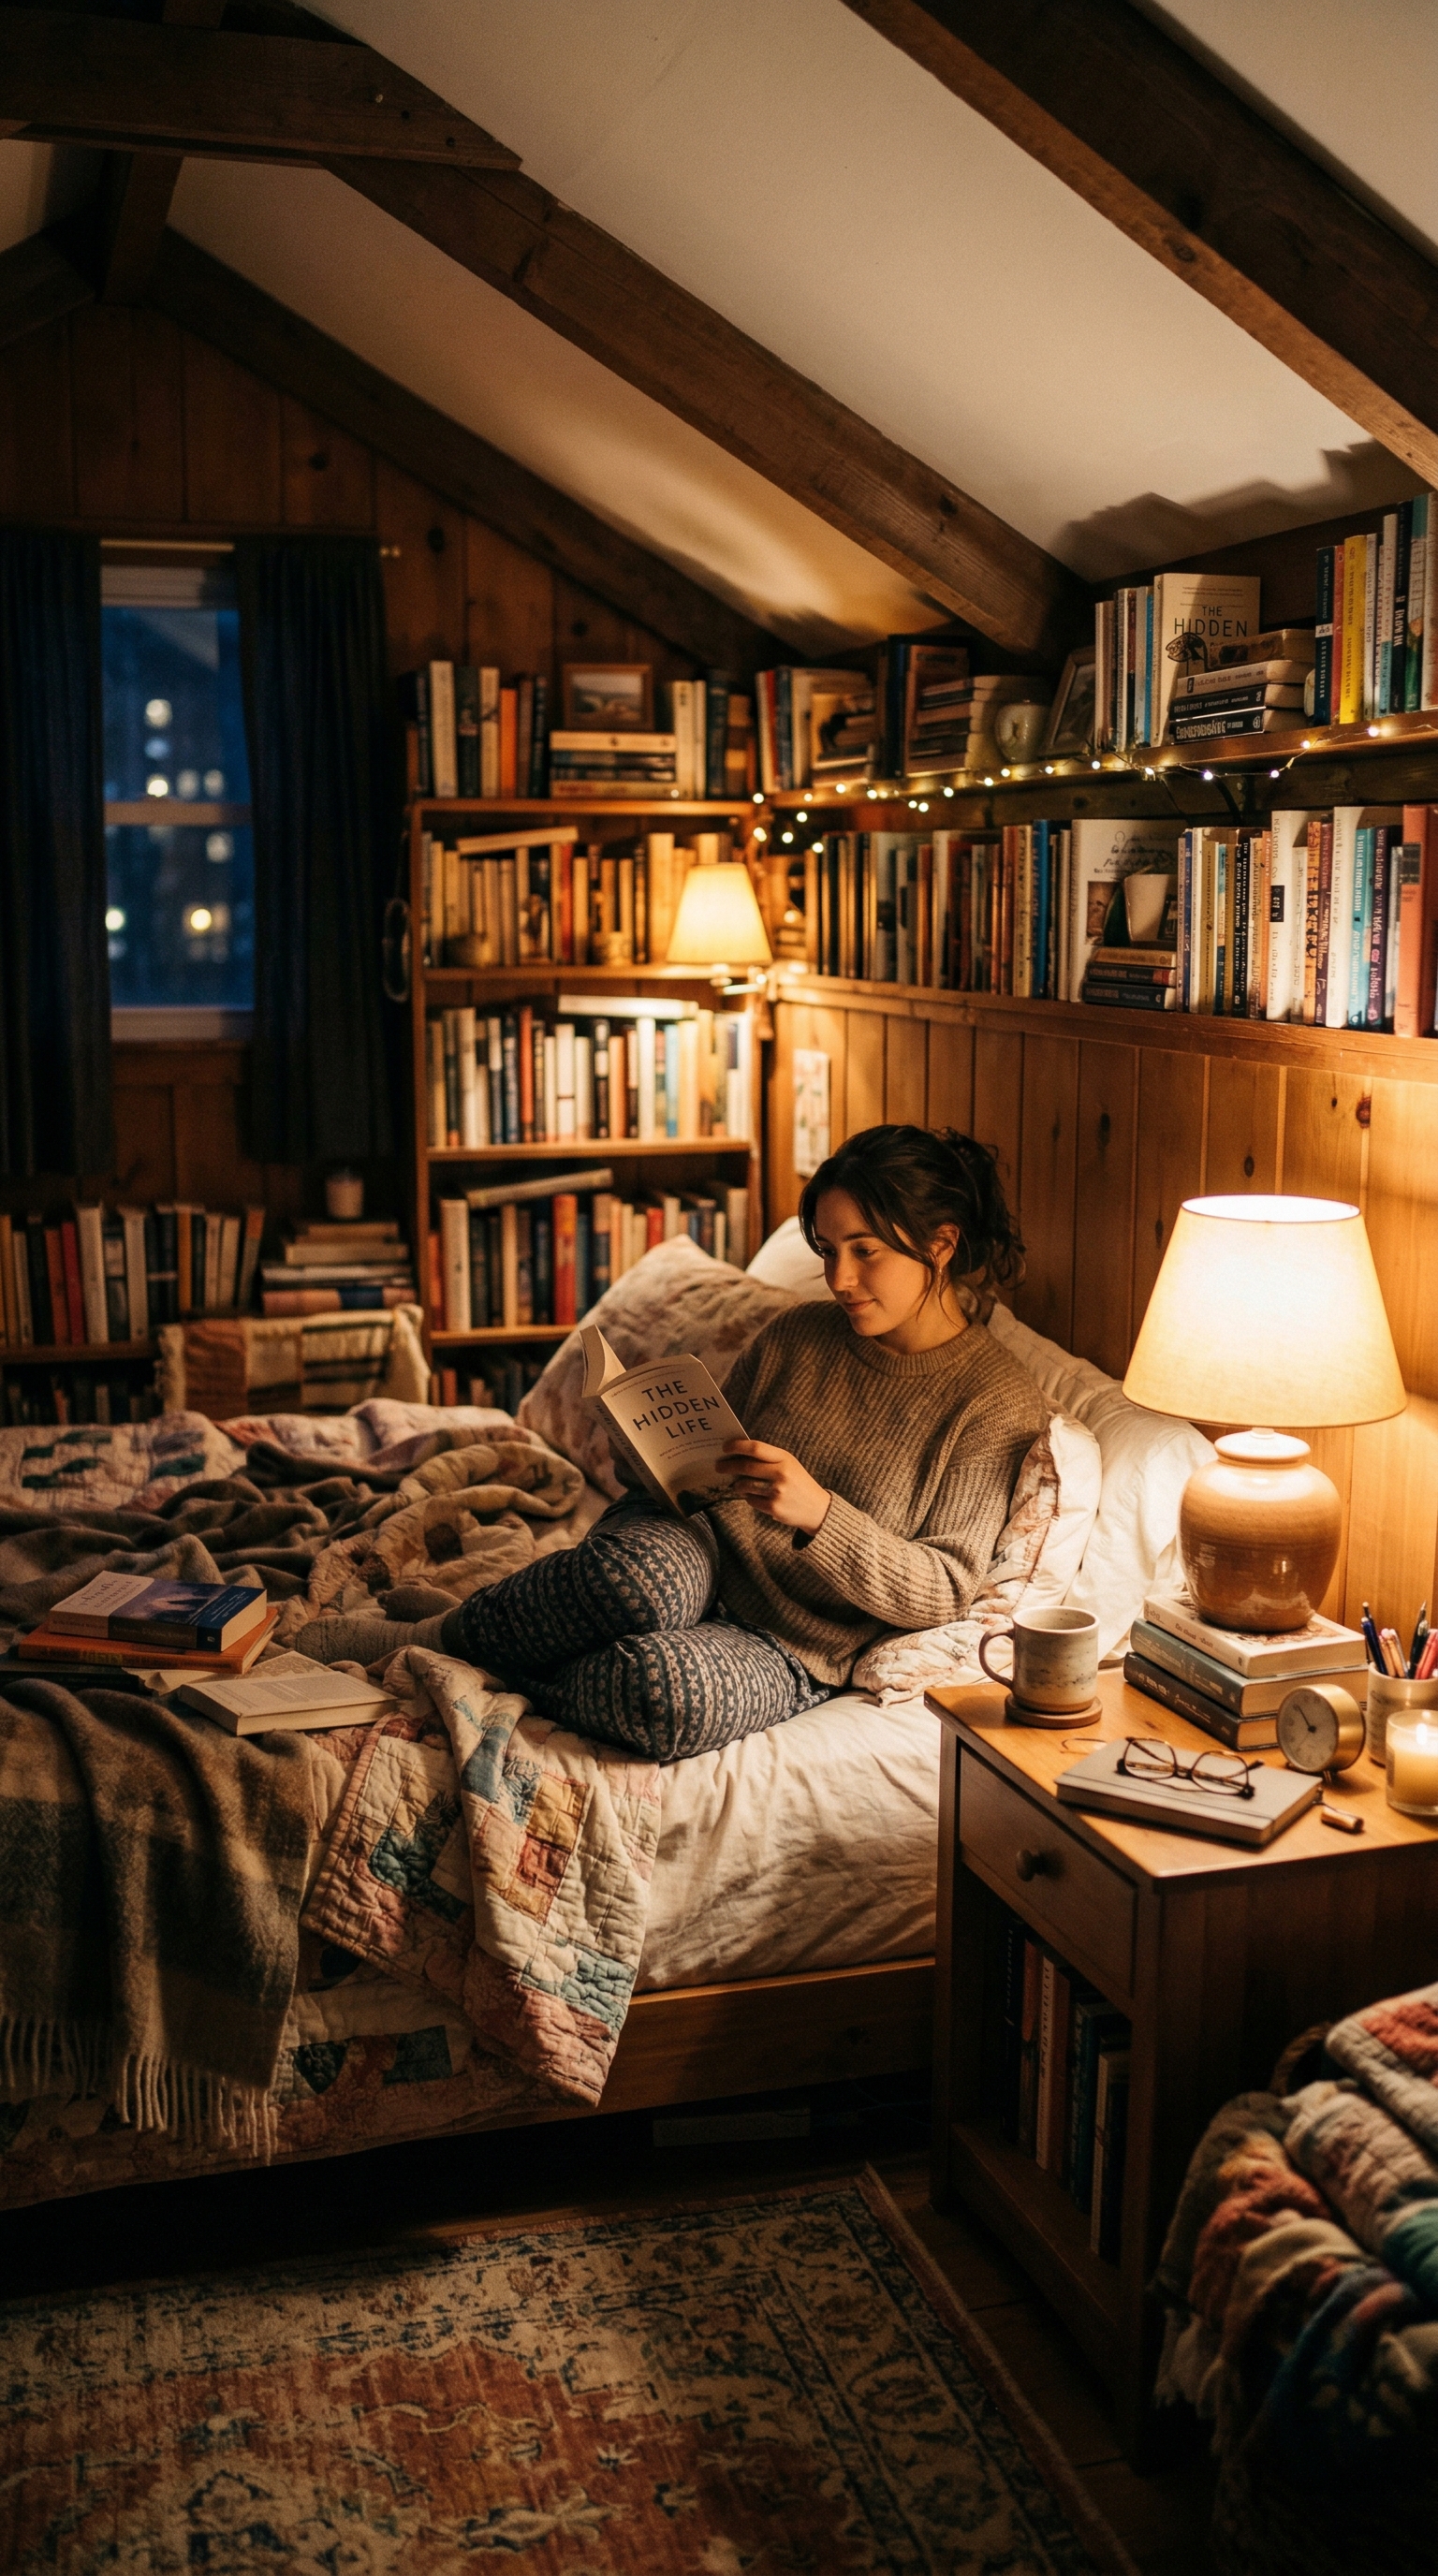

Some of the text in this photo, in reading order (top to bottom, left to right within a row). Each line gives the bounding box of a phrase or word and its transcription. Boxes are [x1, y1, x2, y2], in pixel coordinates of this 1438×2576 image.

[1202, 606, 1223, 617] THE
[1174, 618, 1248, 637] HIDDEN
[641, 1380, 688, 1402] THE
[632, 1396, 721, 1431] HIDDEN
[665, 1417, 712, 1439] LIFE
